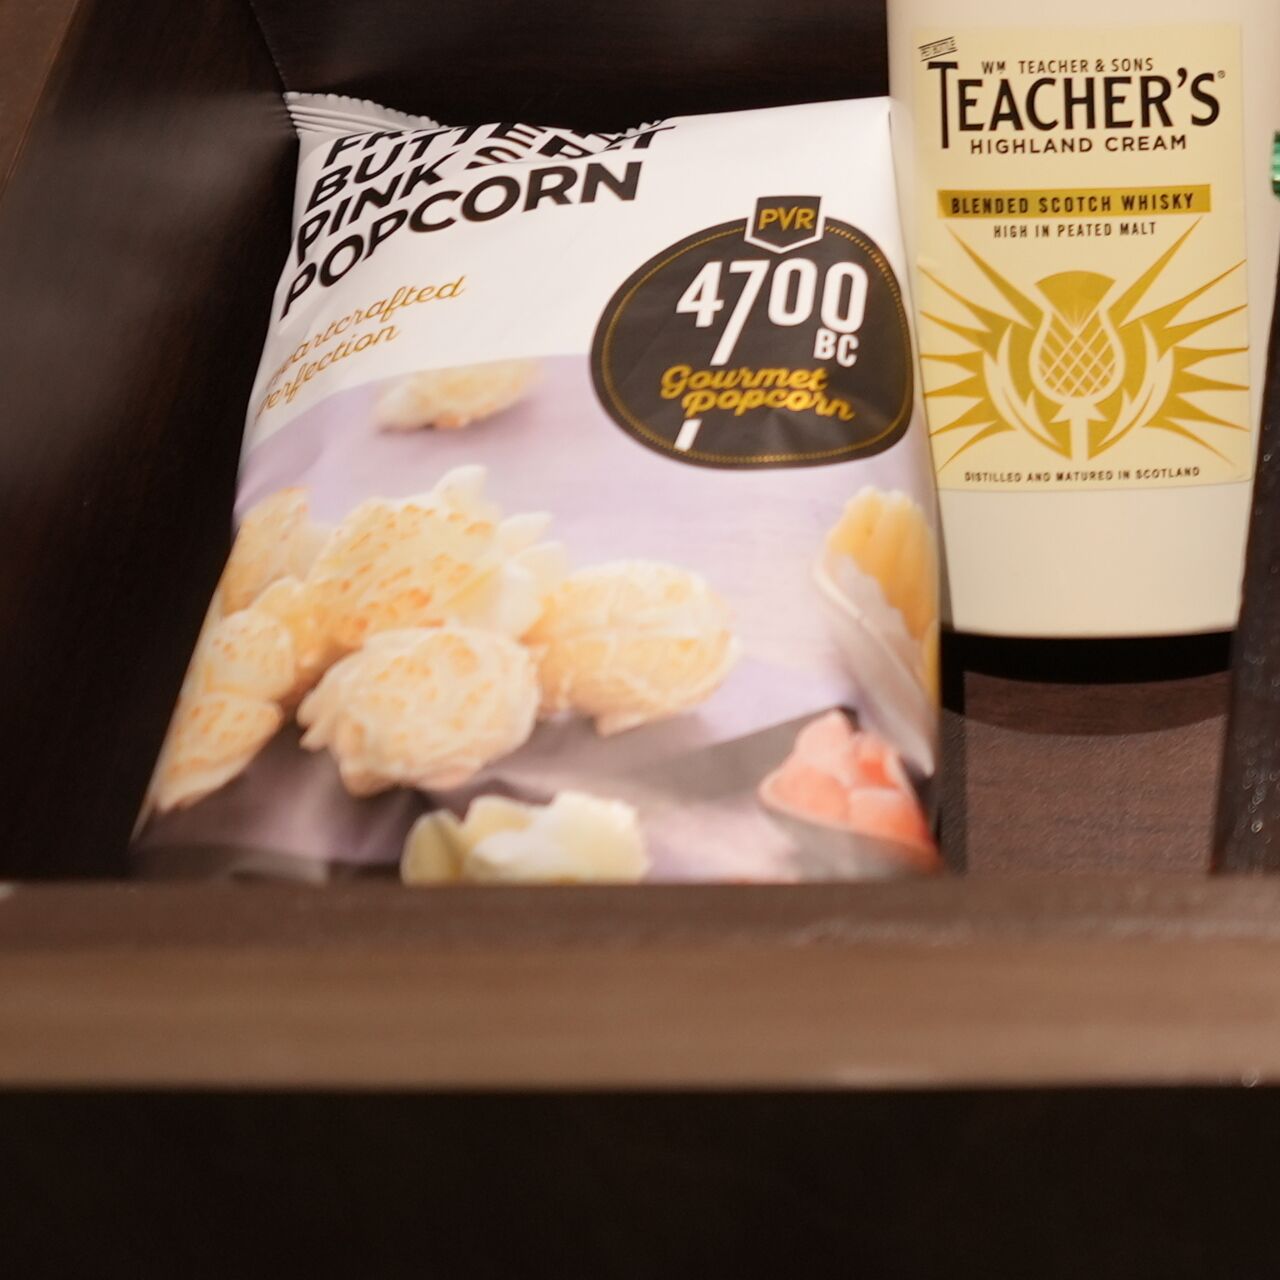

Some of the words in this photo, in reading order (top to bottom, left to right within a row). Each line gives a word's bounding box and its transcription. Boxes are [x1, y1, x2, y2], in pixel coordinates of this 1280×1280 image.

[1018, 59, 1090, 74] TEACHER
[1110, 57, 1154, 72] SONS
[970, 137, 1094, 155] HIGHLAND
[1105, 135, 1188, 152] CREAM
[297, 151, 461, 268] PINK
[951, 195, 1029, 215] BLENDED
[1038, 194, 1112, 213] SCOTCH
[1120, 192, 1195, 212] WHISKY
[757, 206, 816, 233] PVR
[993, 224, 1029, 239] HIGH
[1035, 224, 1051, 238] IN
[1057, 223, 1112, 238] PEATED
[1119, 222, 1157, 236] MALT
[280, 161, 643, 321] POPCORN
[675, 257, 869, 367] 4700
[813, 328, 859, 368] BC
[660, 364, 829, 400] Gourmet
[964, 471, 1022, 483] DISTILLED
[1026, 471, 1052, 483] AND
[1055, 470, 1114, 482] MATURED
[1117, 469, 1131, 480] IN
[1135, 466, 1201, 480] SCOTLAND
